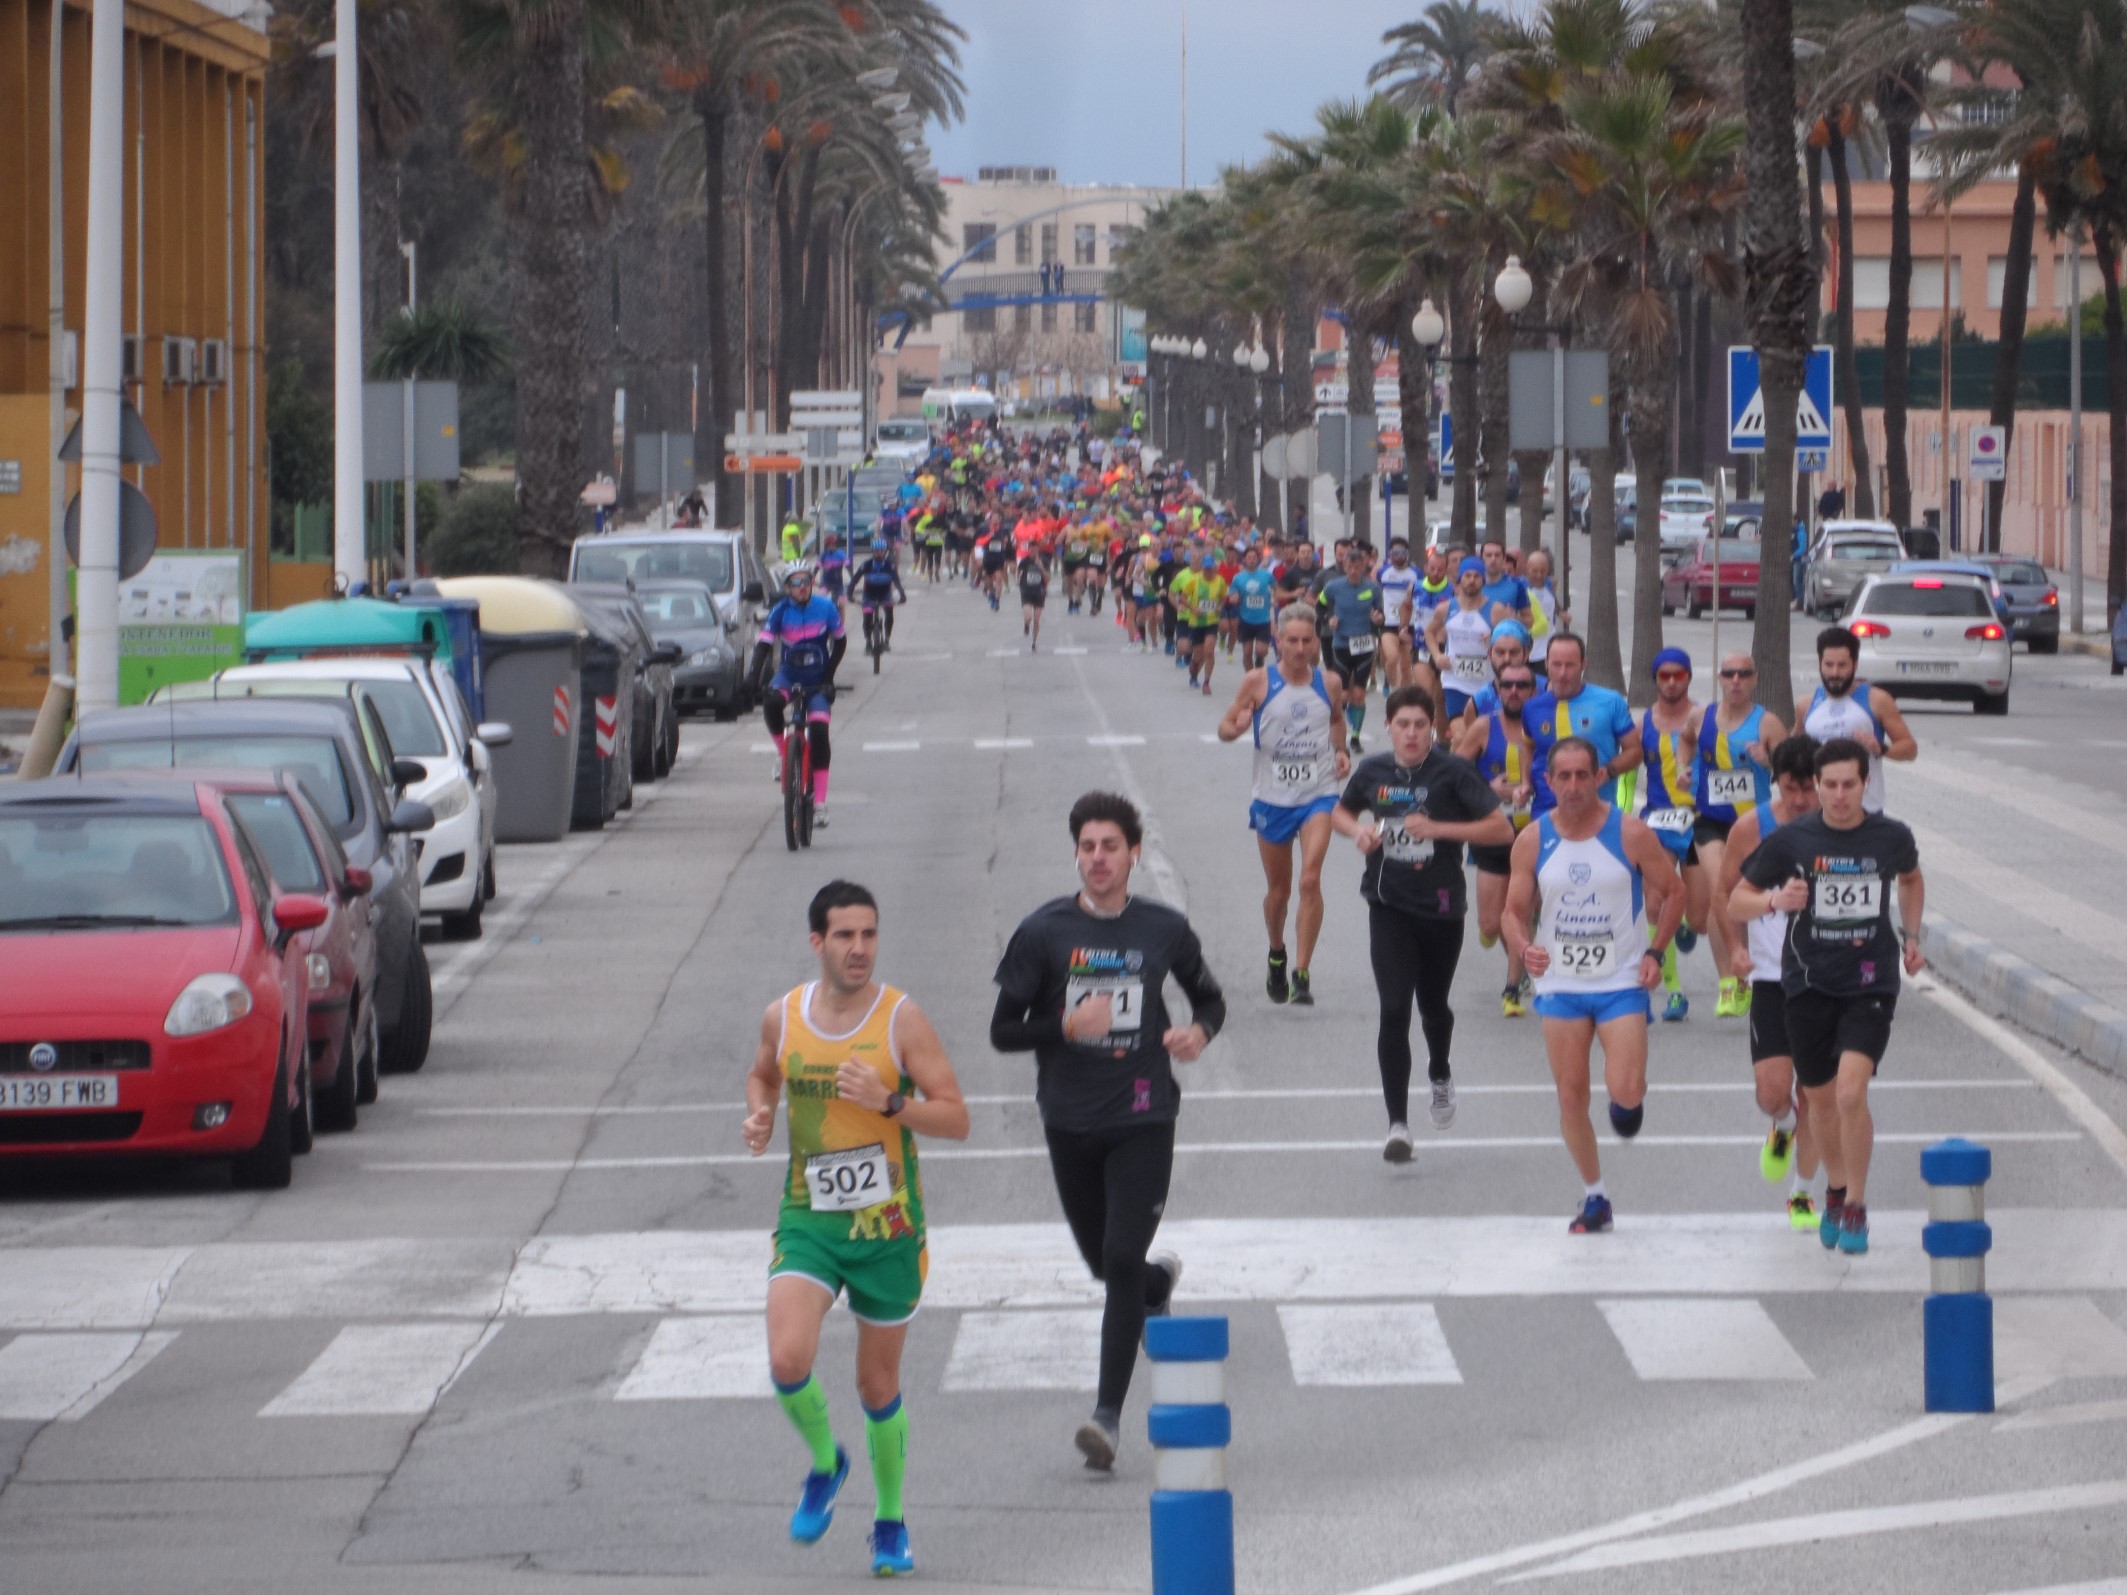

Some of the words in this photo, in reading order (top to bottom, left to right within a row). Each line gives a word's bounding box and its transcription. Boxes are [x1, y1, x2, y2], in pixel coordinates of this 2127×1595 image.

[1458, 660, 1483, 673] 442
[1278, 764, 1311, 781] 305
[1714, 776, 1748, 794] 544
[1383, 827, 1424, 845] 36
[1824, 884, 1872, 906] 361
[1556, 909, 1612, 923] Linense
[1562, 944, 1607, 967] 529
[62, 1080, 105, 1104] FWB
[817, 1161, 878, 1196] 502
